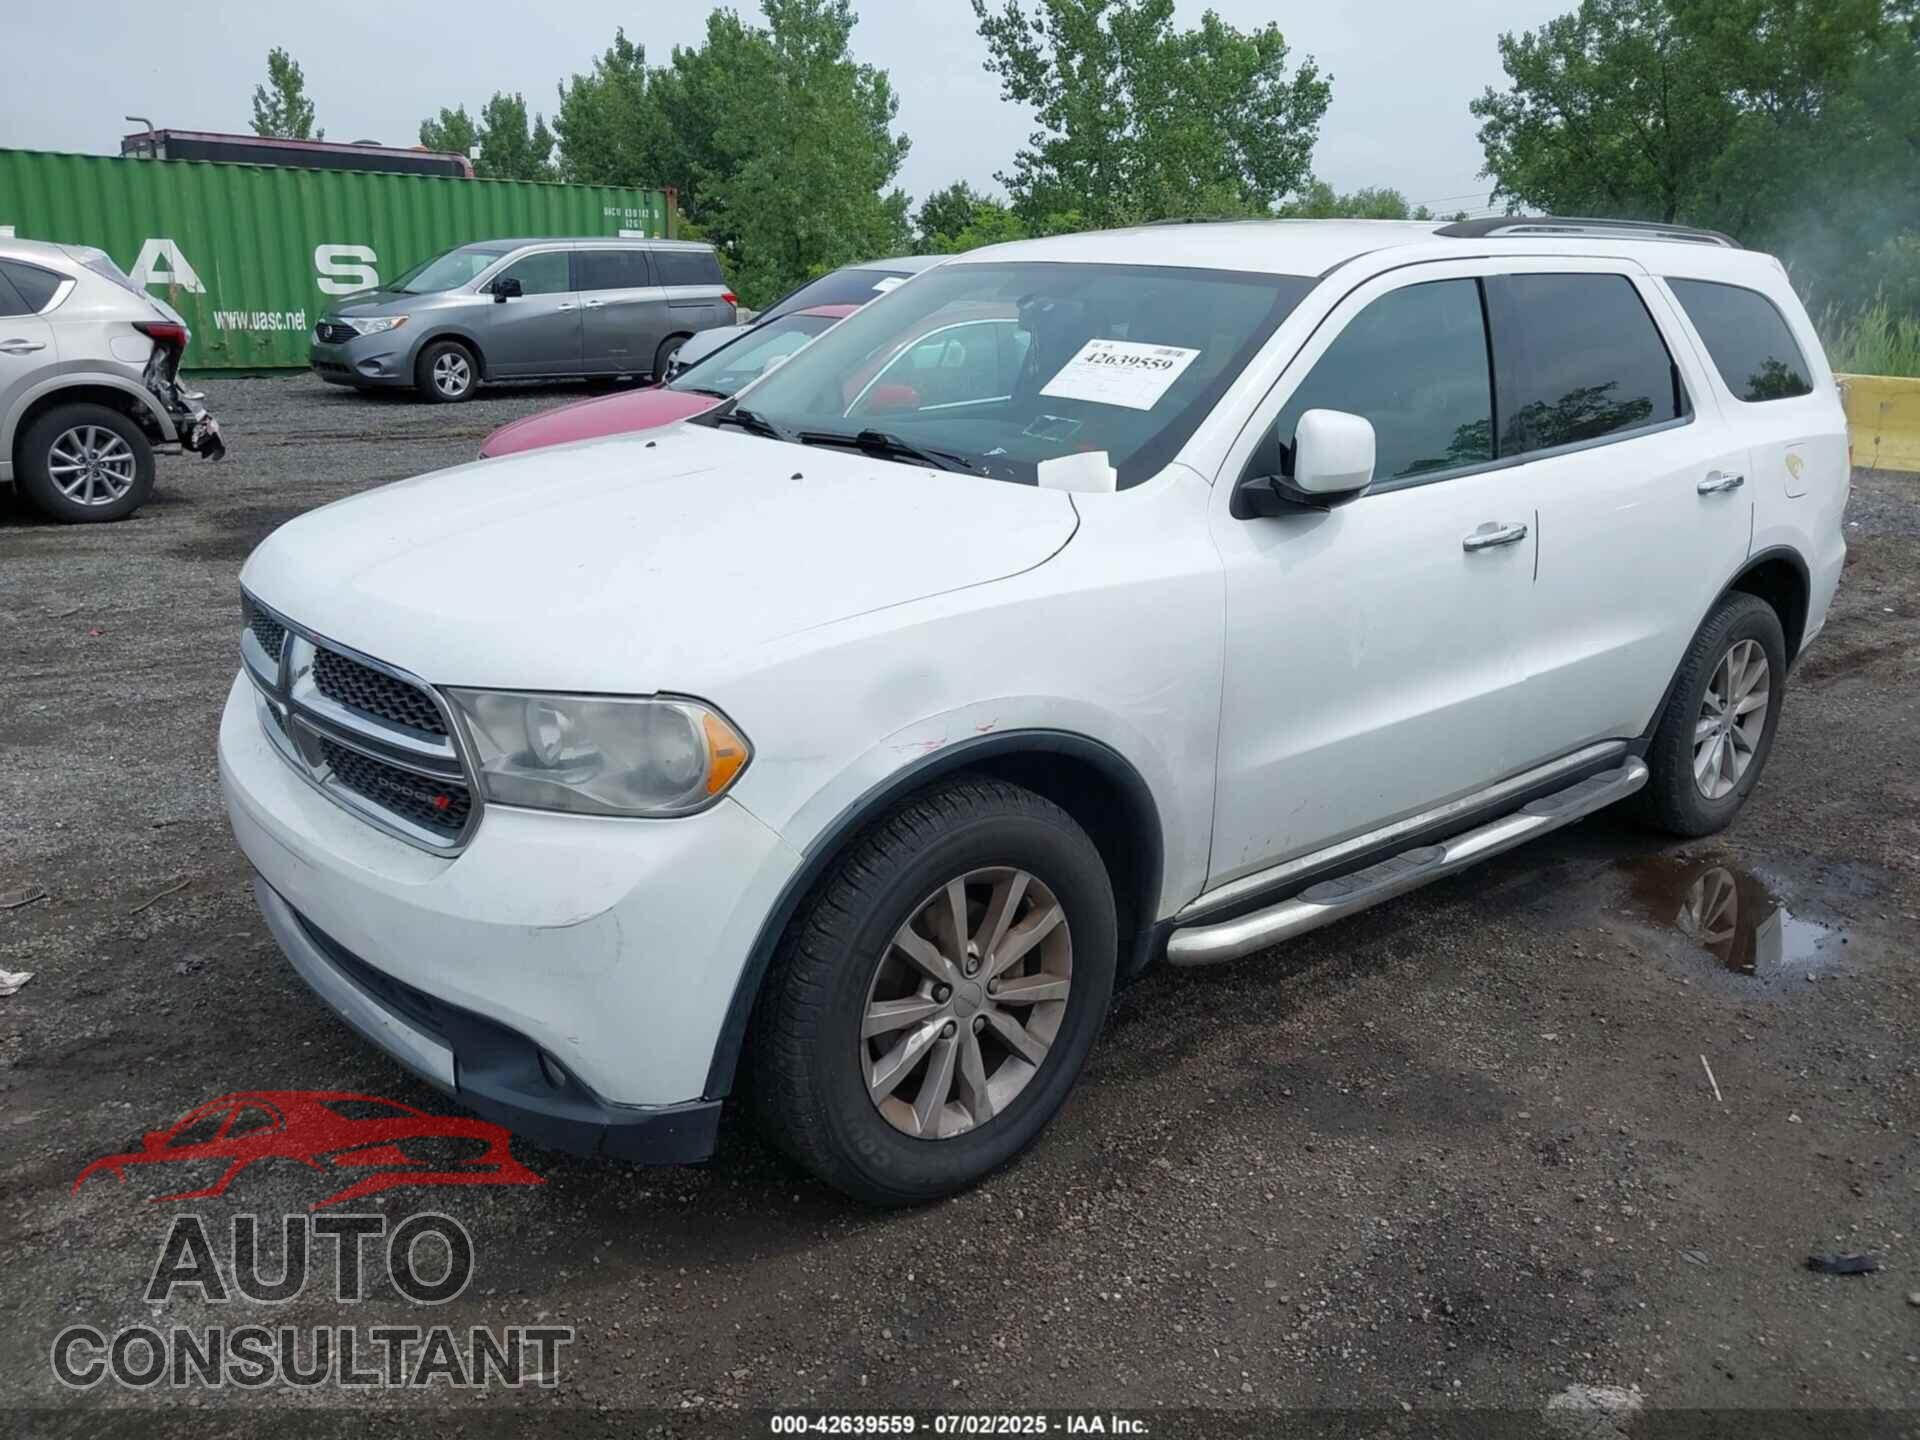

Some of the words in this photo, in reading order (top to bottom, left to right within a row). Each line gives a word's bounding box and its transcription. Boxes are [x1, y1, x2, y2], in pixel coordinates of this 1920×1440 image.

[128, 238, 207, 293] A
[314, 244, 379, 294] S
[213, 308, 307, 331] www.uasc.net
[1085, 352, 1174, 371] 42639559
